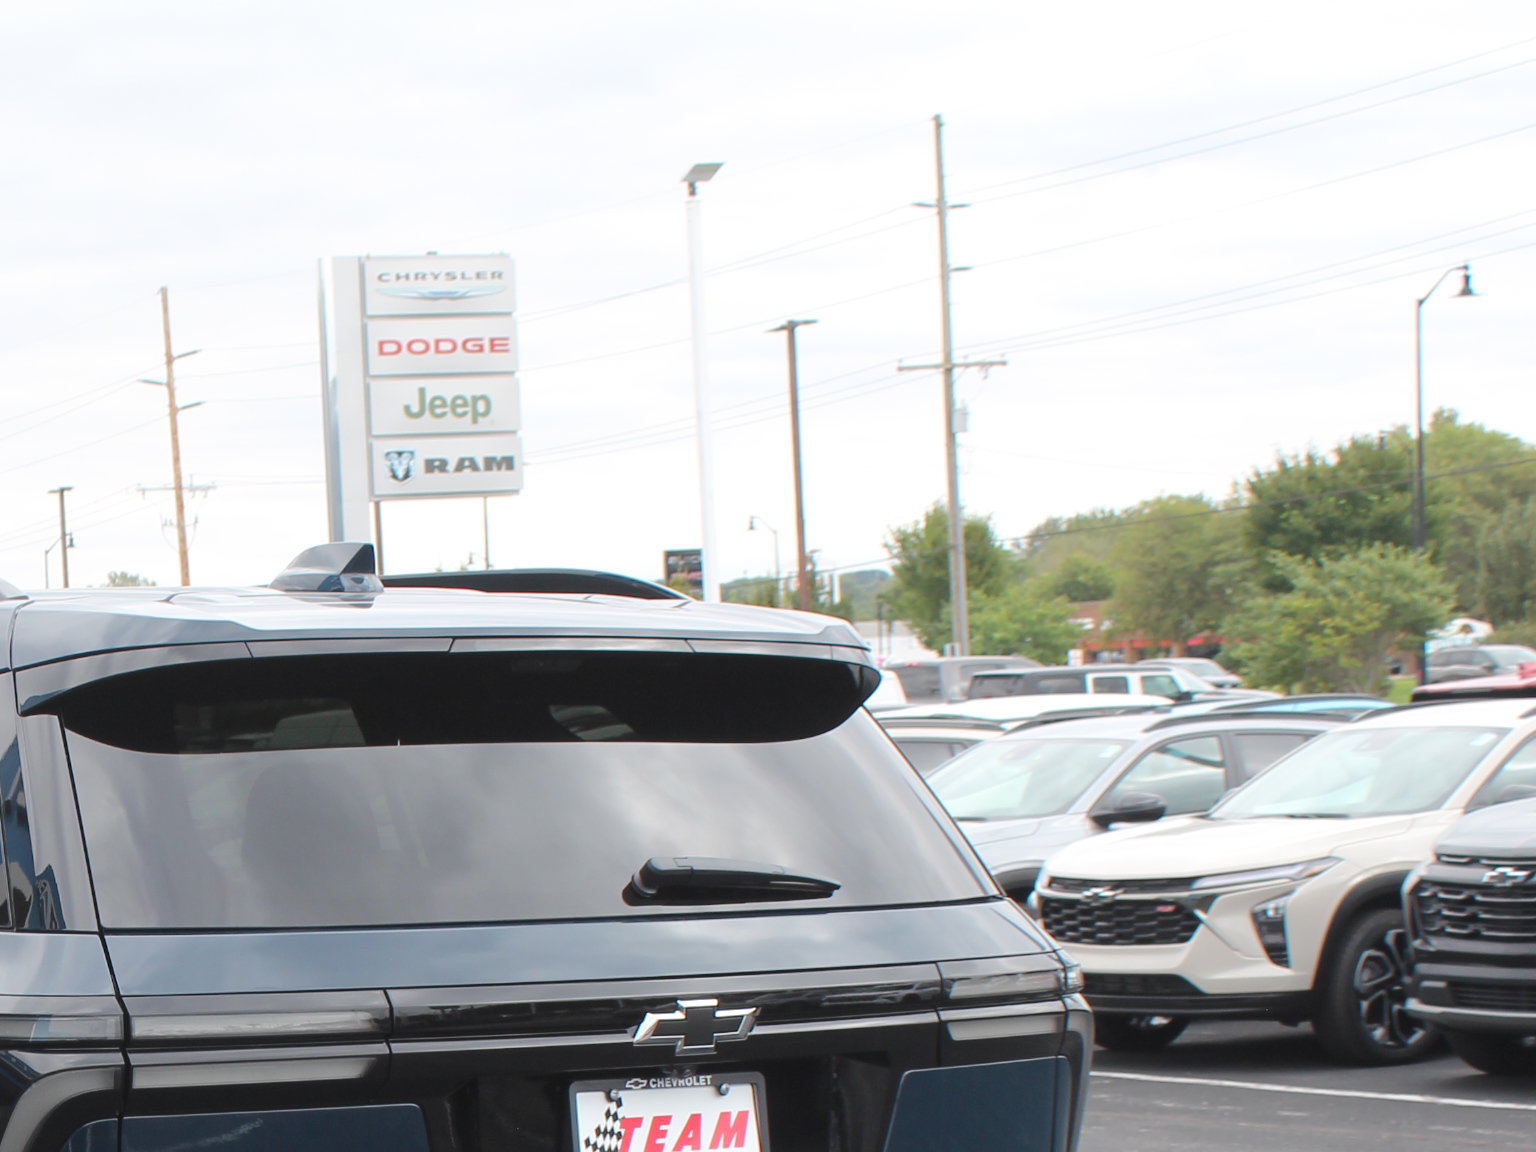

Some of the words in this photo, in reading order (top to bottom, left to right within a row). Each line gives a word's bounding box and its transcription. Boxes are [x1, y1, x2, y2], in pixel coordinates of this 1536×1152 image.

[376, 271, 504, 282] CHRYSLER
[378, 337, 511, 356] DODGE
[403, 387, 492, 424] Jeep
[424, 456, 515, 474] RAM
[649, 1074, 713, 1089] CHEVROLET
